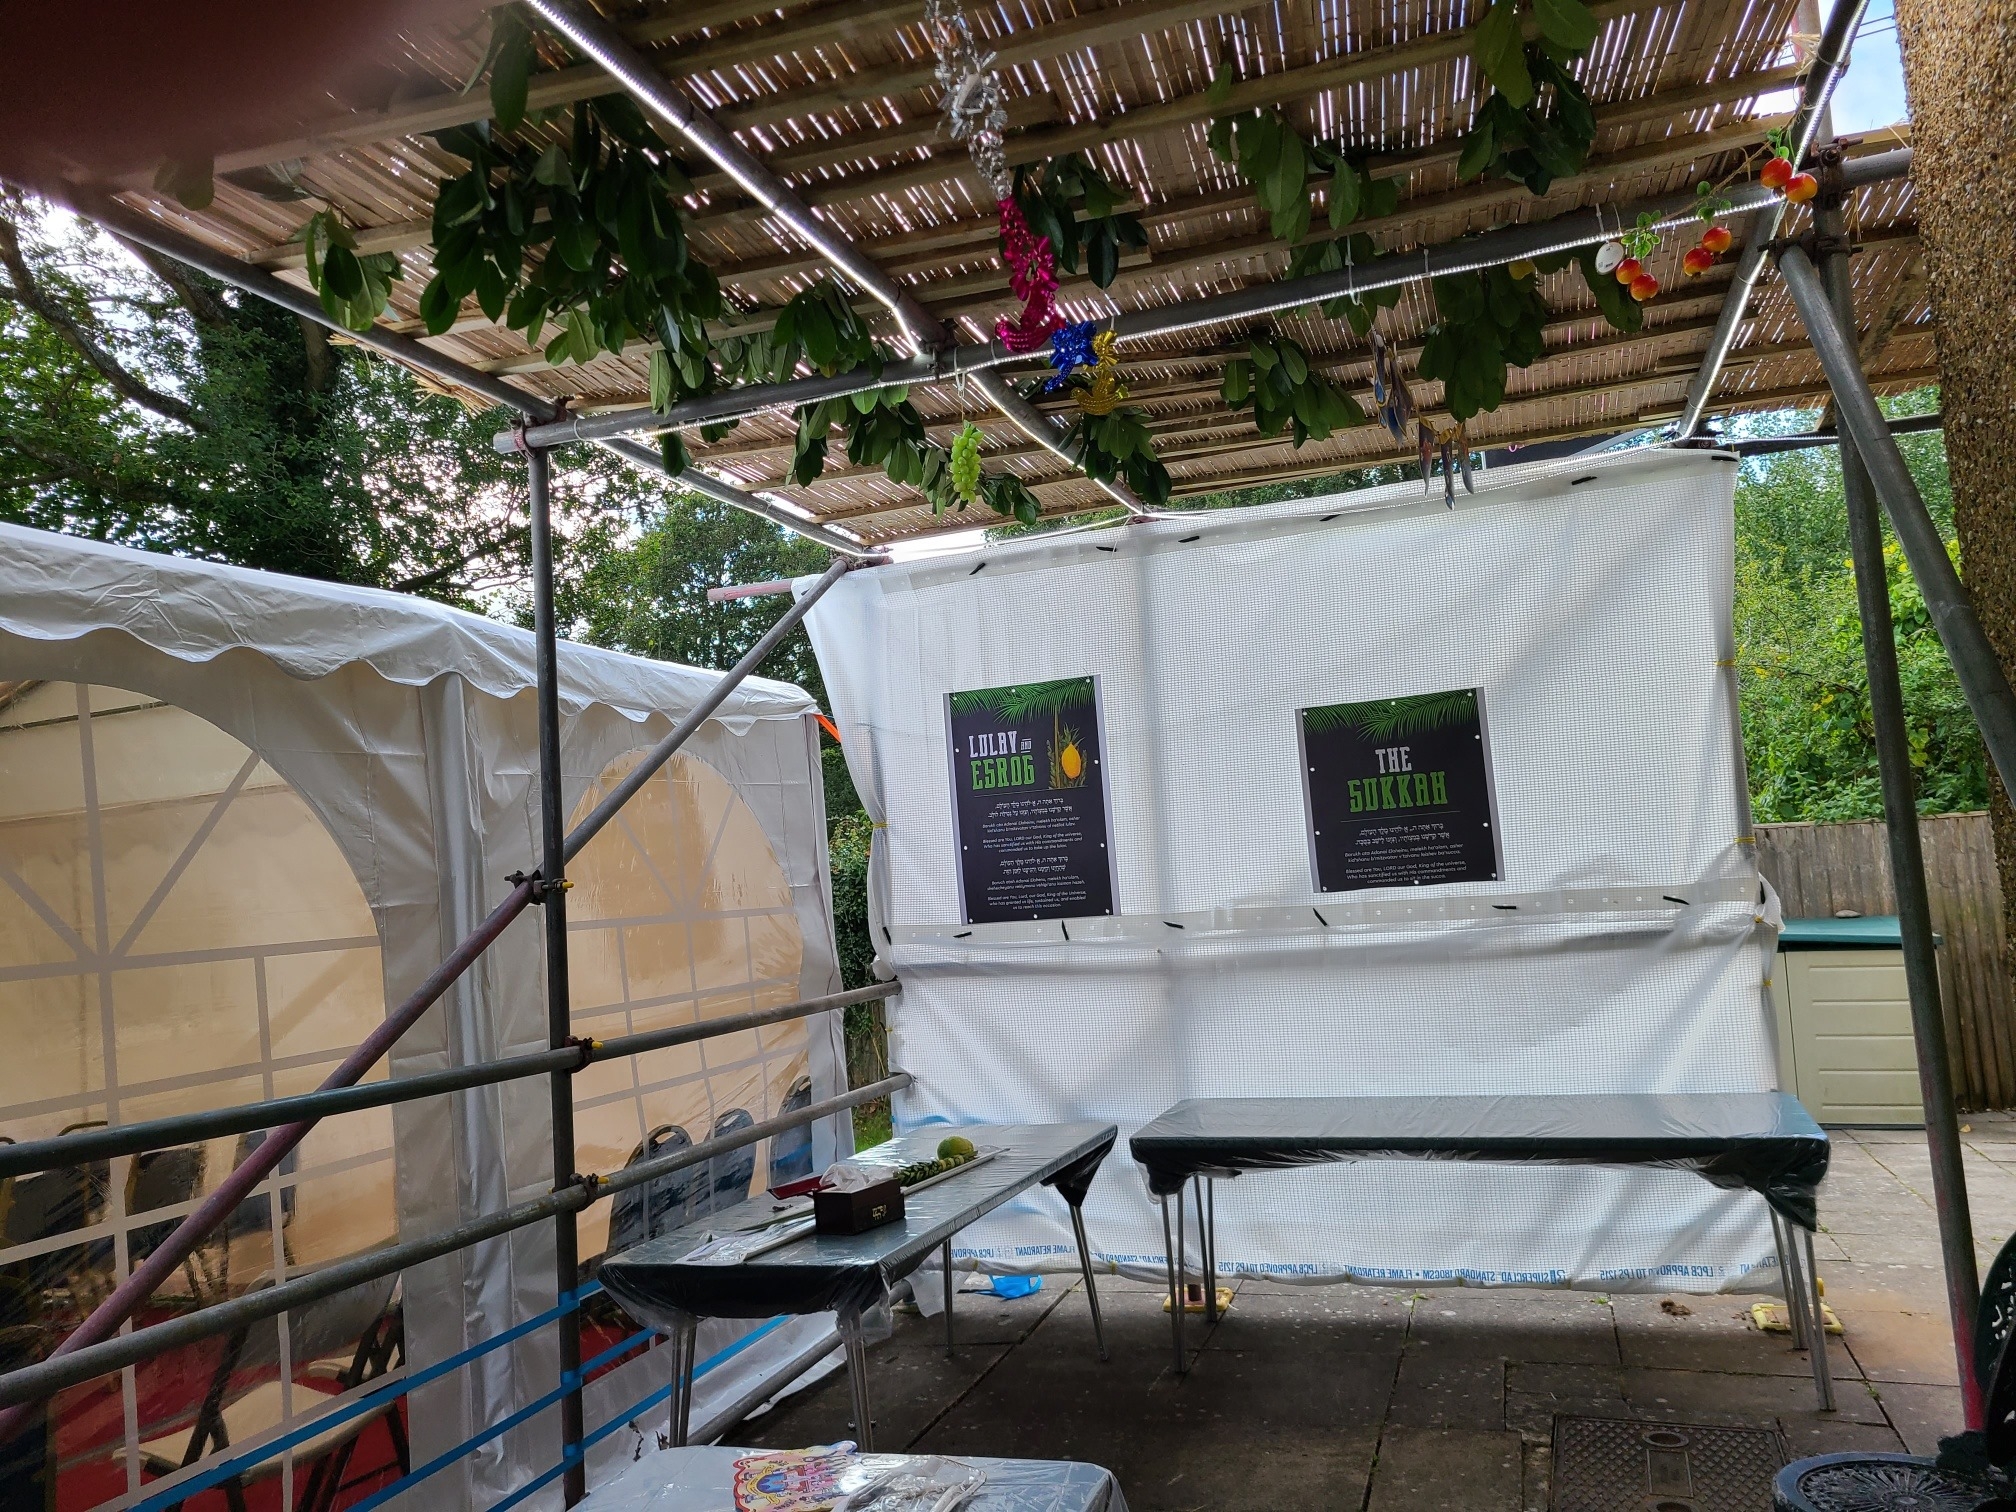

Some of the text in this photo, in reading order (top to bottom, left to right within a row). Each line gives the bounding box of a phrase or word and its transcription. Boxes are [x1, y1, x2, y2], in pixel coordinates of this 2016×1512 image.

[969, 731, 1017, 758] LULAV
[971, 755, 1034, 790] ESROG
[1375, 747, 1412, 774] THE
[1348, 771, 1448, 812] SUKKAH
